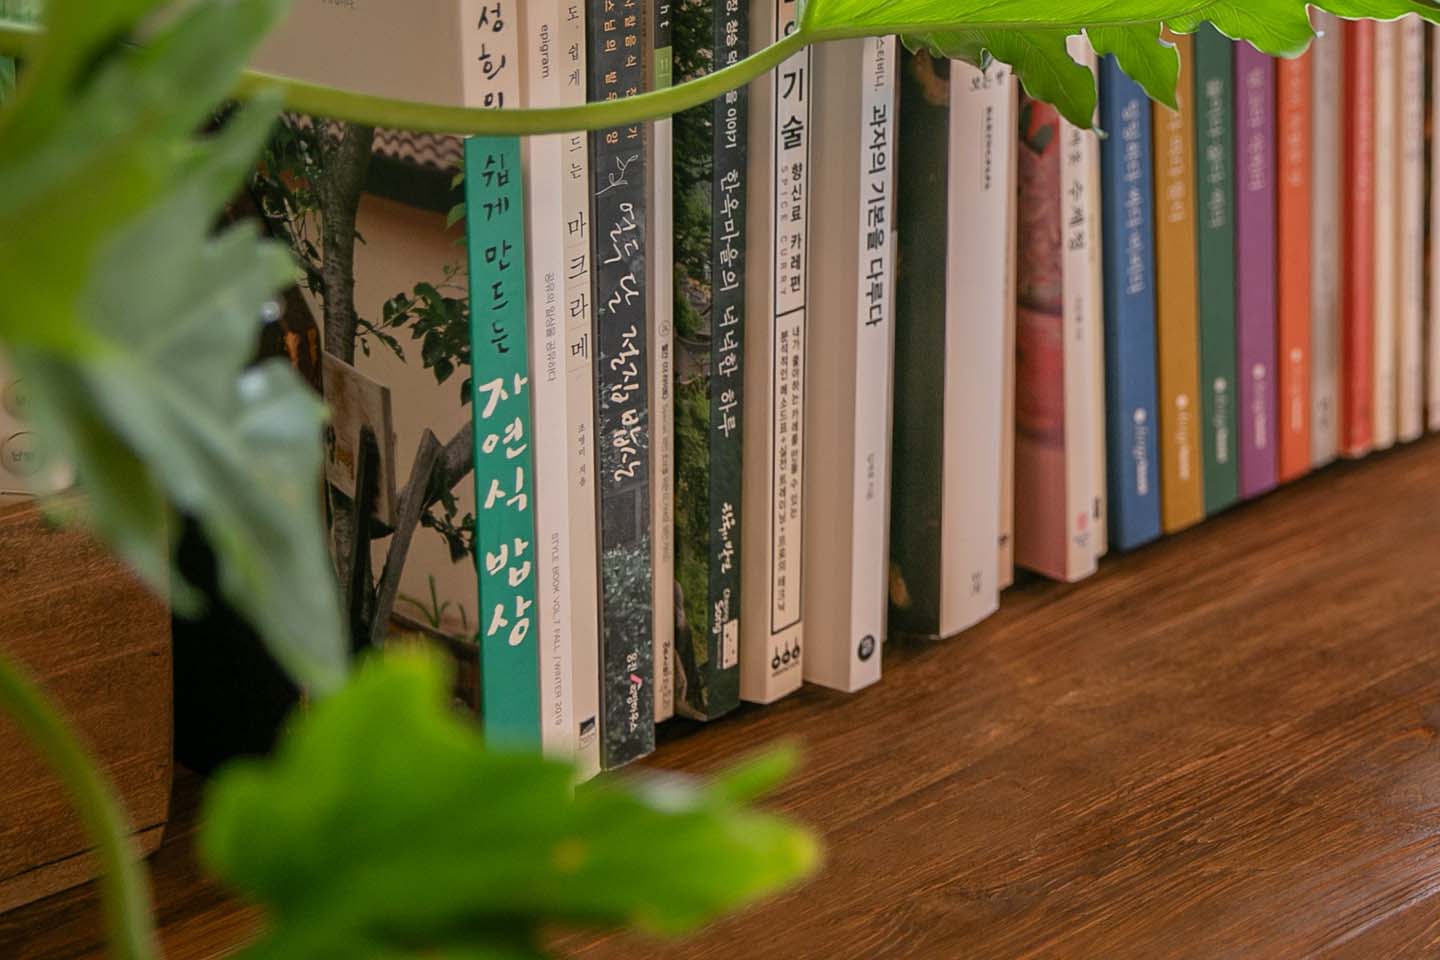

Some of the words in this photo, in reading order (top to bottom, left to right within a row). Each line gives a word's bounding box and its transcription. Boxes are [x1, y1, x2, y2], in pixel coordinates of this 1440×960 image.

[539, 23, 551, 80] epigram
[603, 0, 618, 53] 스님의
[726, 20, 739, 47] 청송
[567, 42, 581, 87] 쉽게
[725, 50, 739, 104] 덕을
[874, 39, 886, 92] 스터비니.
[604, 70, 619, 145] 발우양
[626, 87, 639, 140] 전가
[724, 107, 738, 149] 이야기
[780, 68, 805, 151] 기술
[868, 103, 888, 174] 과자의
[480, 152, 510, 223] 쉽게
[779, 165, 789, 221] SPICE
[789, 162, 803, 222] 향신료
[866, 182, 887, 251] 기본을
[604, 201, 640, 265] 열두
[719, 168, 741, 292] 한옥마을의
[567, 211, 590, 360] 마크라메
[607, 272, 640, 314] 달
[778, 234, 788, 295] CURRY
[788, 233, 802, 294] 카레편
[864, 258, 884, 328] 다루다
[484, 238, 514, 355] 만드는
[718, 305, 739, 378] 넉넉한
[479, 371, 529, 513] 자연식
[717, 388, 739, 438] 하루
[551, 531, 560, 564] STYLE
[485, 537, 533, 647] 밥상
[552, 565, 561, 594] BOOK
[552, 628, 561, 652] FALL
